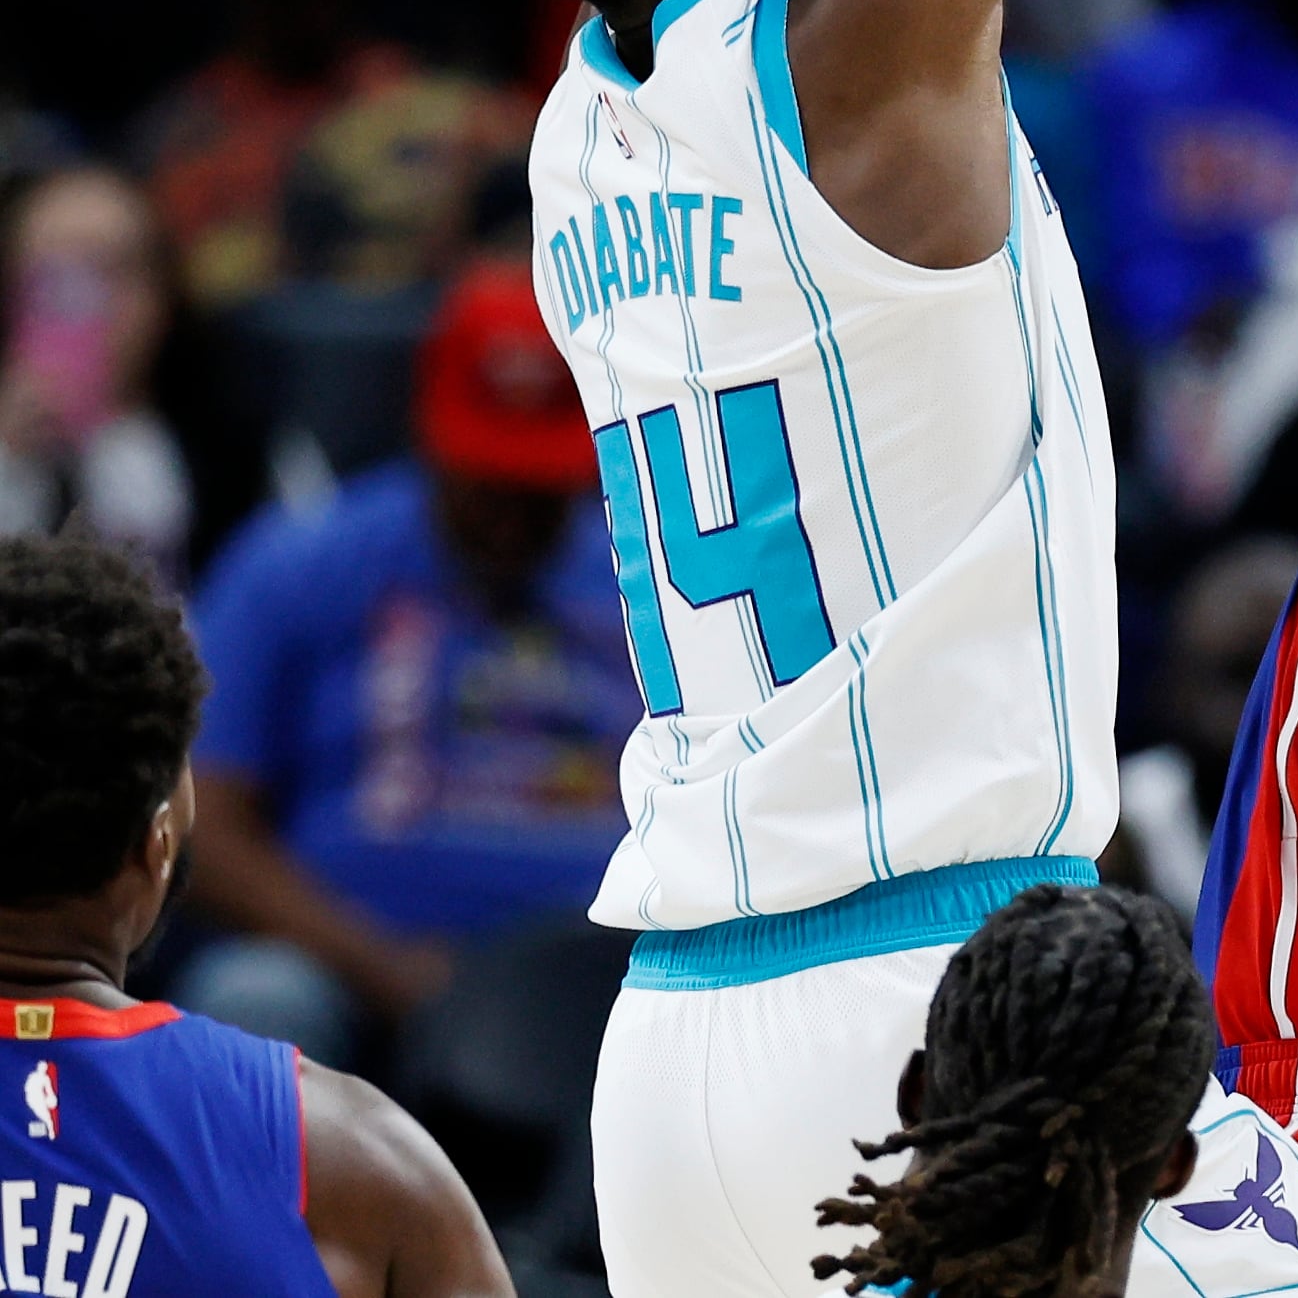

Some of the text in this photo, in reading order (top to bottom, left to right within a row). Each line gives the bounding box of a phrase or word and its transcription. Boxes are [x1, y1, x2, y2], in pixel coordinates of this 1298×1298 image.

[549, 192, 742, 337] DIABATE
[592, 378, 836, 718] 14
[0, 1179, 148, 1298] EED
